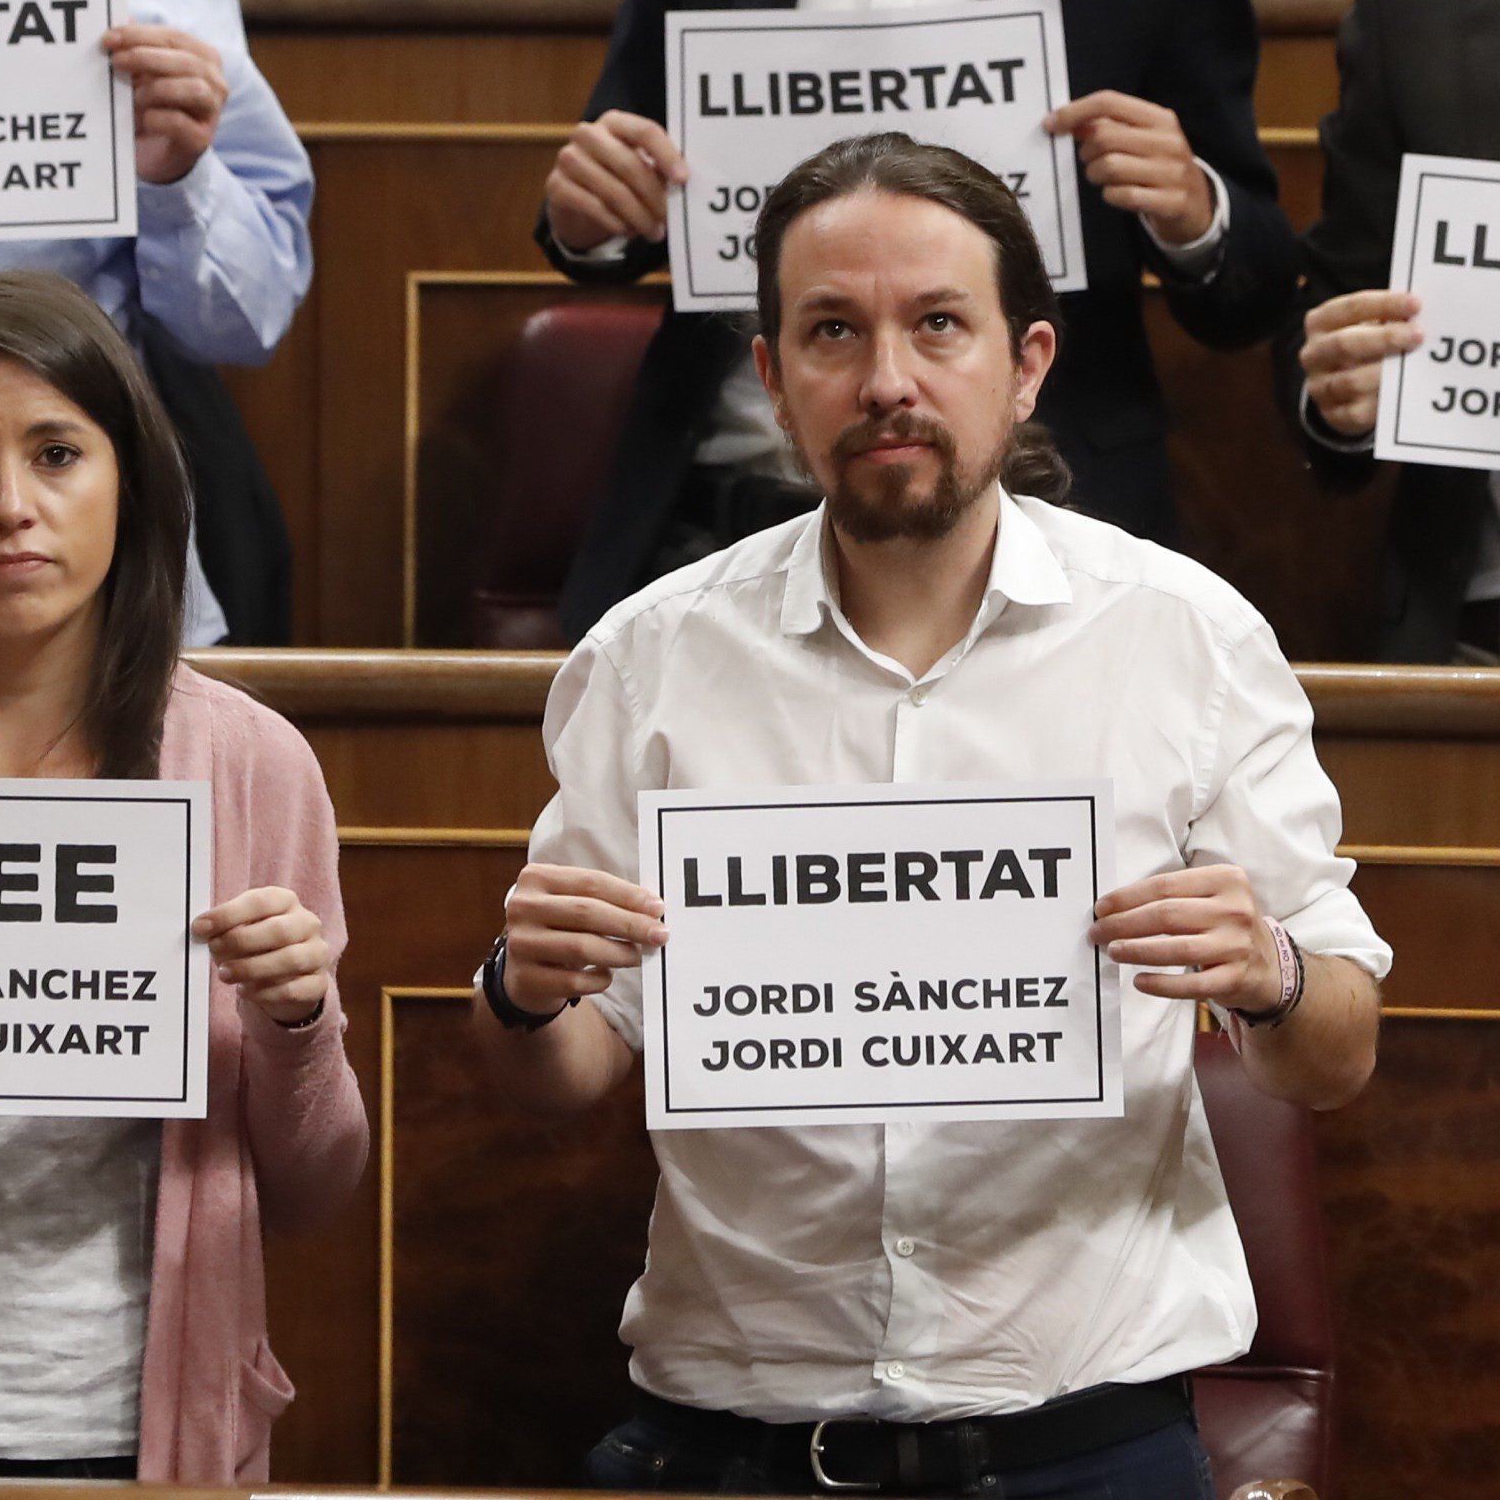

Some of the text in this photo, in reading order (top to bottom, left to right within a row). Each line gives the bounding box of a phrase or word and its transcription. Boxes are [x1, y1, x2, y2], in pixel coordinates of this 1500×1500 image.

[699, 58, 1025, 117] LLIBERTAT
[684, 847, 1071, 907] LLIBERTAT
[693, 971, 1069, 1017] JORDI SÀNCHEZ
[702, 1031, 1063, 1071] JORDI CUIXART
